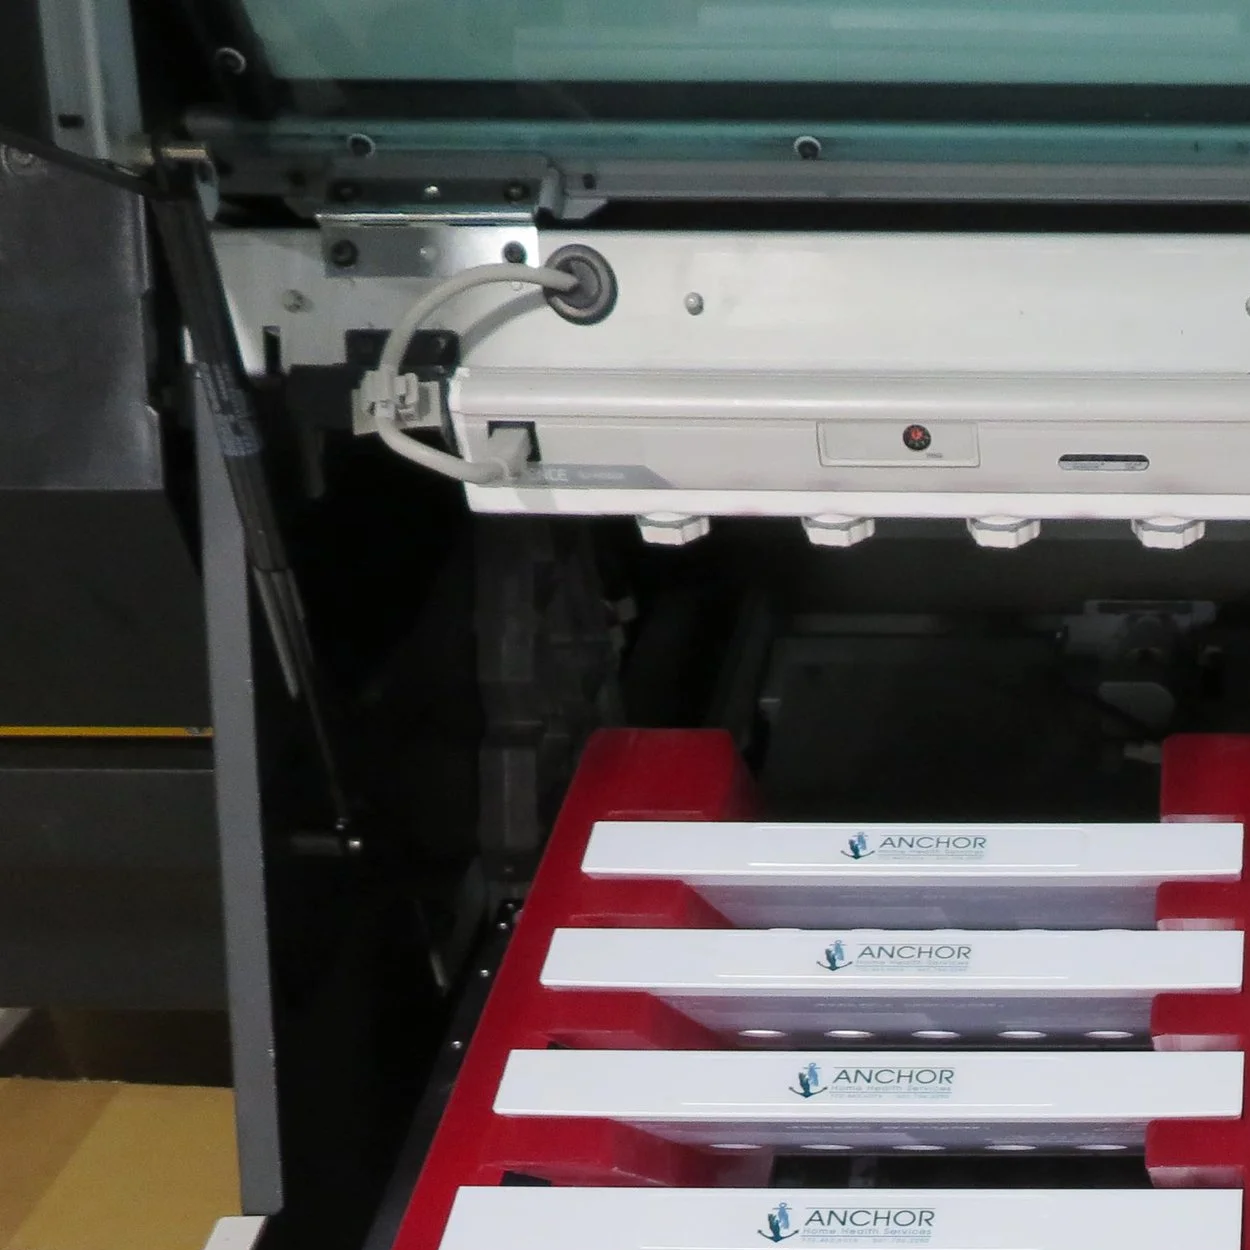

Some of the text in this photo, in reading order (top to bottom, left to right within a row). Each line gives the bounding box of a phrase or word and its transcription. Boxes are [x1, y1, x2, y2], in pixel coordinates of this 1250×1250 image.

[879, 836, 987, 849] ANCHOR
[858, 945, 972, 959] ANCHOR
[833, 1069, 955, 1084] ANCHOR
[804, 1210, 935, 1227] ANCHOR
[803, 1227, 932, 1235] Home Health Services
